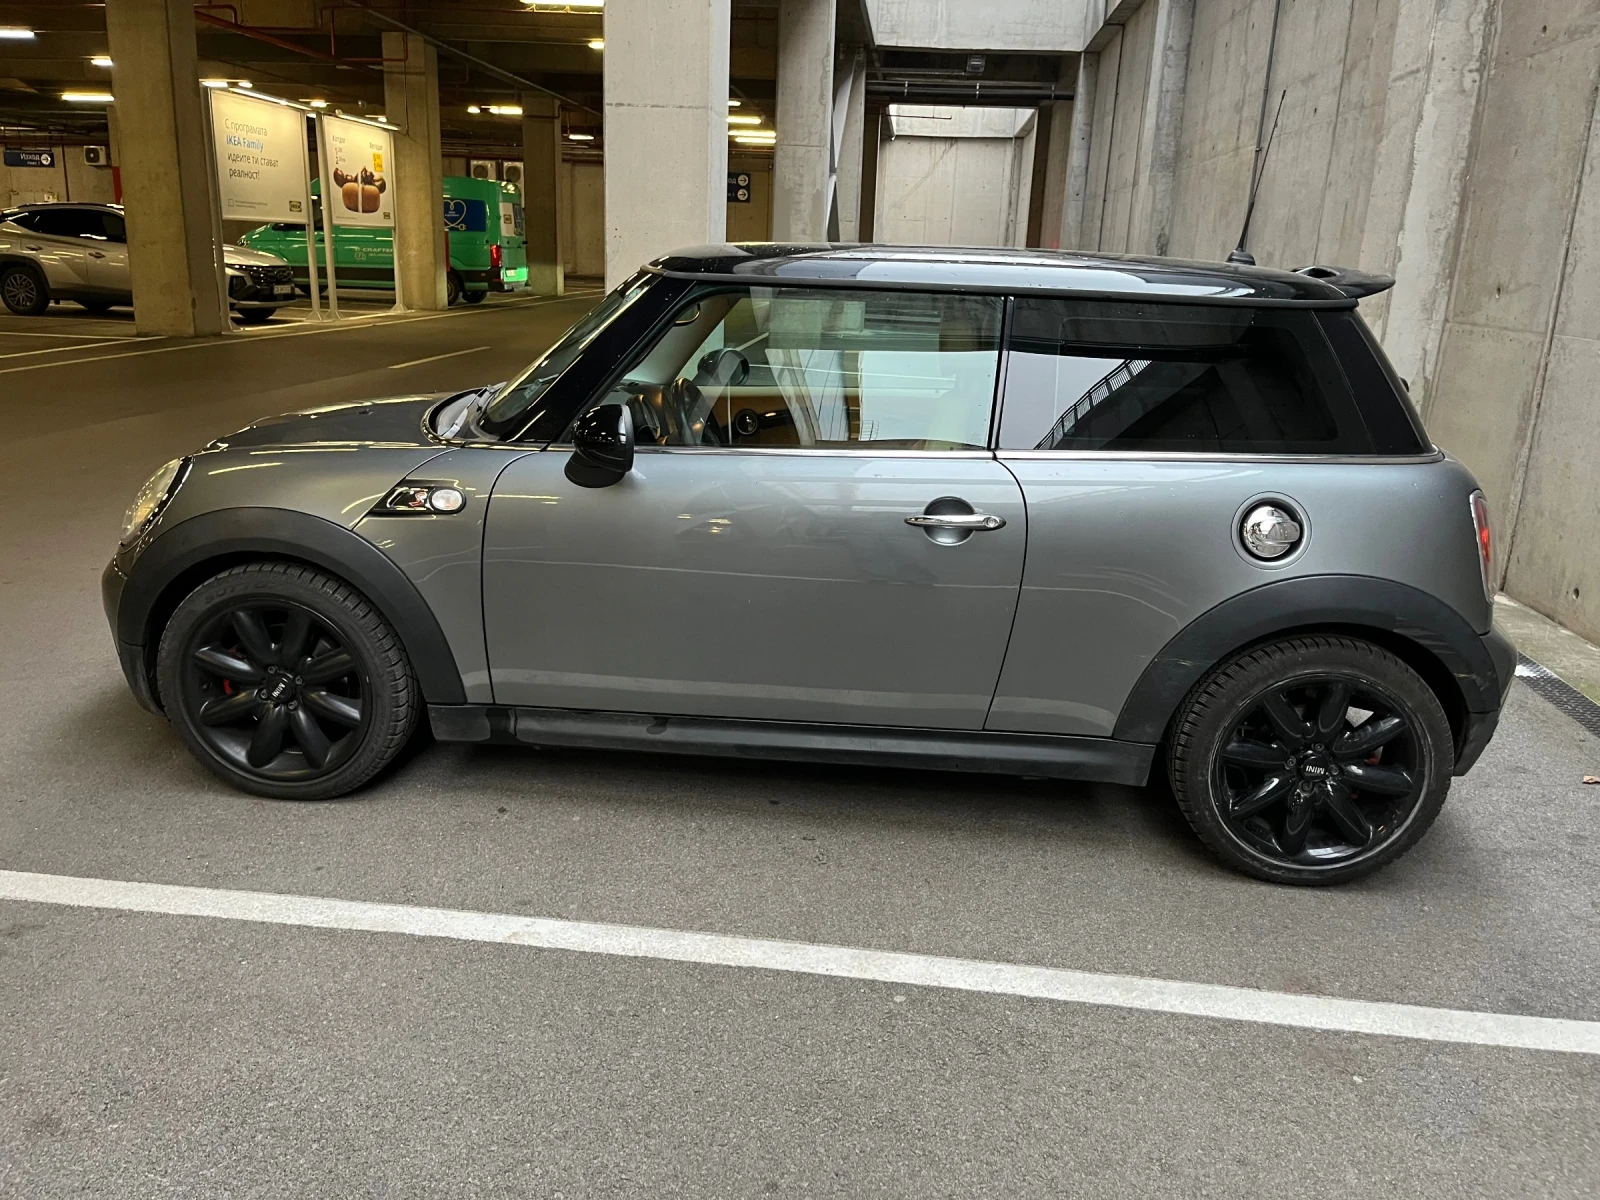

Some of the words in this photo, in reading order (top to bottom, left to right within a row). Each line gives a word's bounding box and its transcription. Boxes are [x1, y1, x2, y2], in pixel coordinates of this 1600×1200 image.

[224, 118, 230, 129] С
[230, 121, 268, 136] програмата
[226, 134, 242, 147] IKEA
[242, 137, 264, 153] Family
[227, 152, 251, 164] идеите
[252, 156, 260, 165] ти
[260, 157, 279, 168] стават
[228, 168, 261, 180] реалност!
[1305, 765, 1325, 775] MINI
